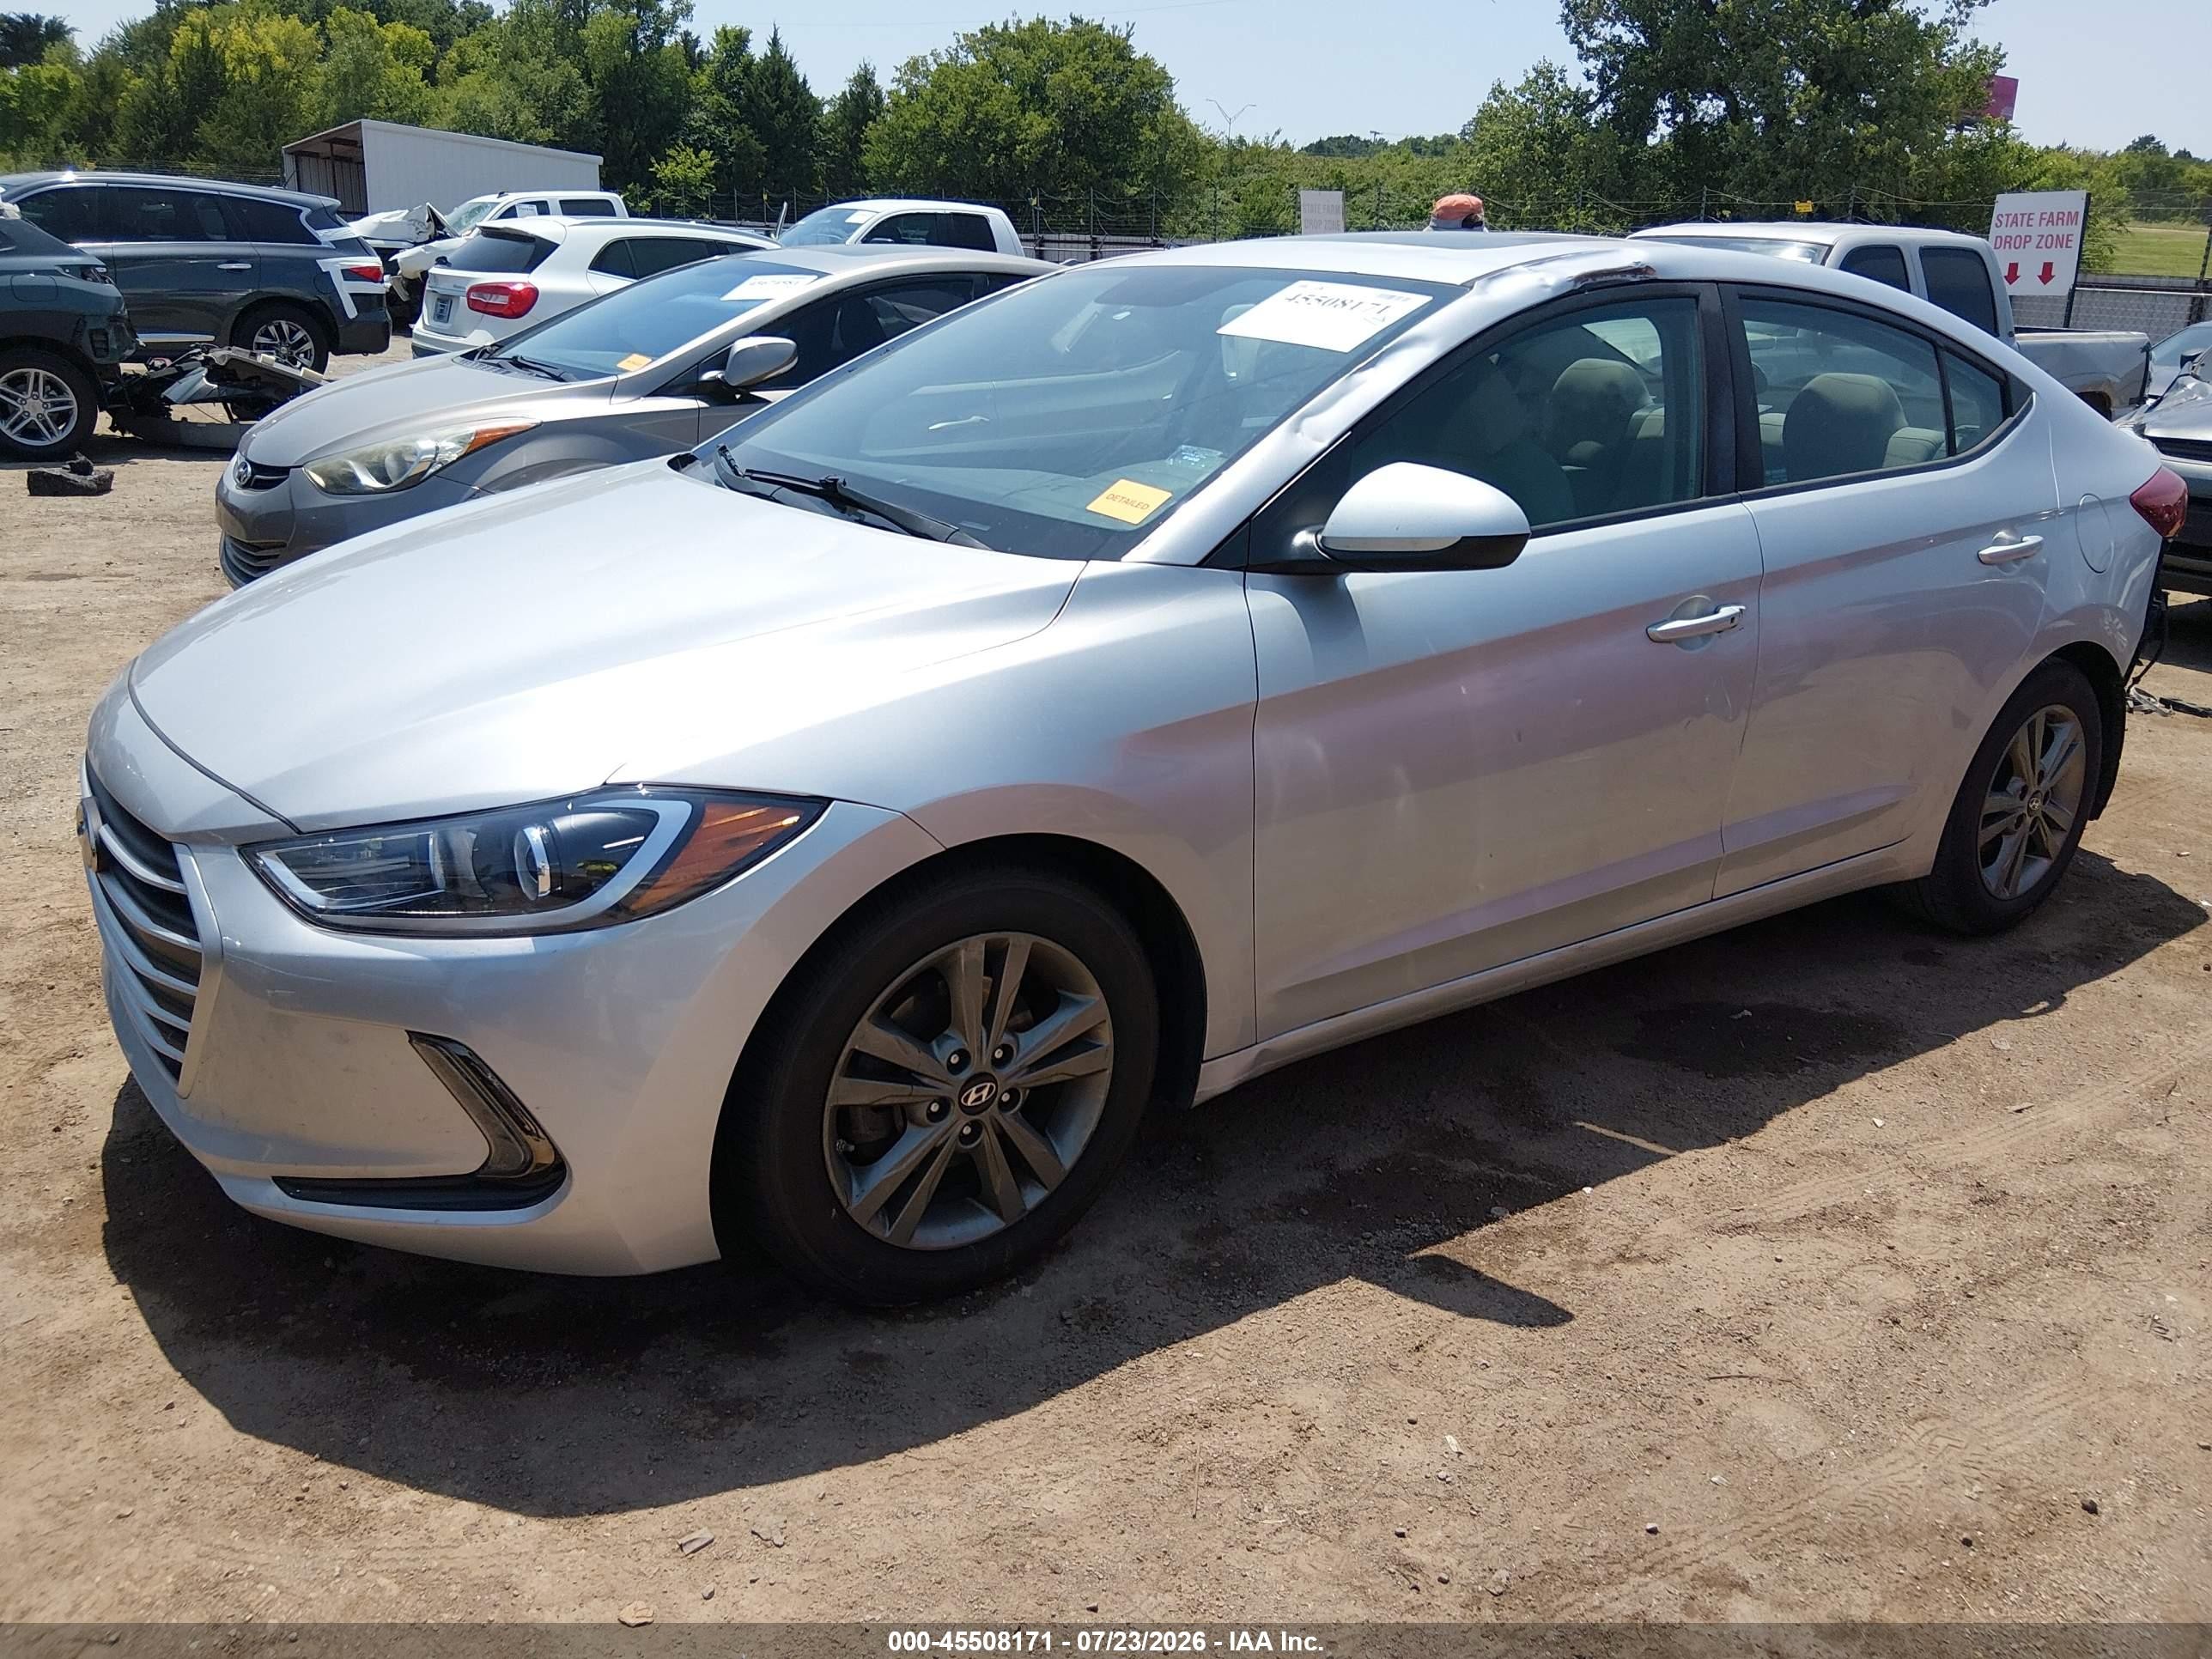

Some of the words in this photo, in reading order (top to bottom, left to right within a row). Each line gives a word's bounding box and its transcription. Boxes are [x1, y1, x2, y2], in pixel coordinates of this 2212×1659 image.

[1995, 212, 2035, 228] STATE
[2039, 211, 2079, 227] FARM
[1993, 234, 2033, 250] DROP
[2035, 234, 2075, 249] ZONE
[1105, 493, 1150, 510] DETAILED
